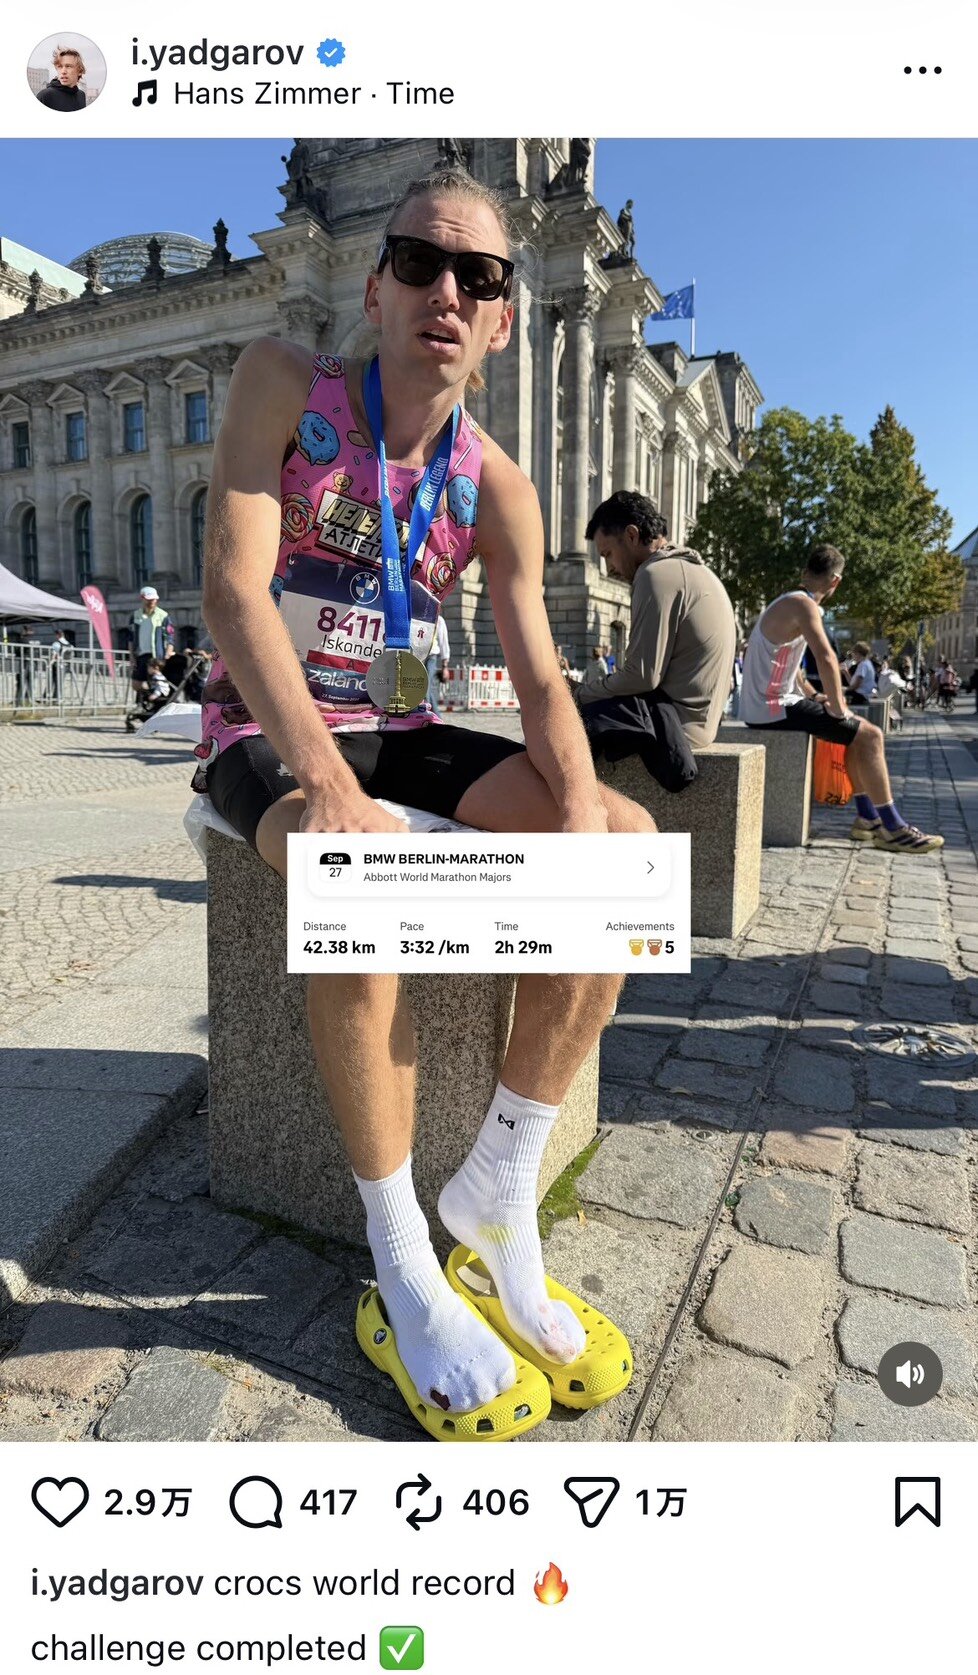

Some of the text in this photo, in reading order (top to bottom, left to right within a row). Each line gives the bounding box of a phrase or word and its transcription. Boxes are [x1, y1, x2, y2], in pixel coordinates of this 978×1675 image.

[420, 457, 448, 512] BERLIN LEGEND
[317, 606, 386, 644] 8411
[322, 634, 383, 659] Iskande
[346, 659, 355, 671] A
